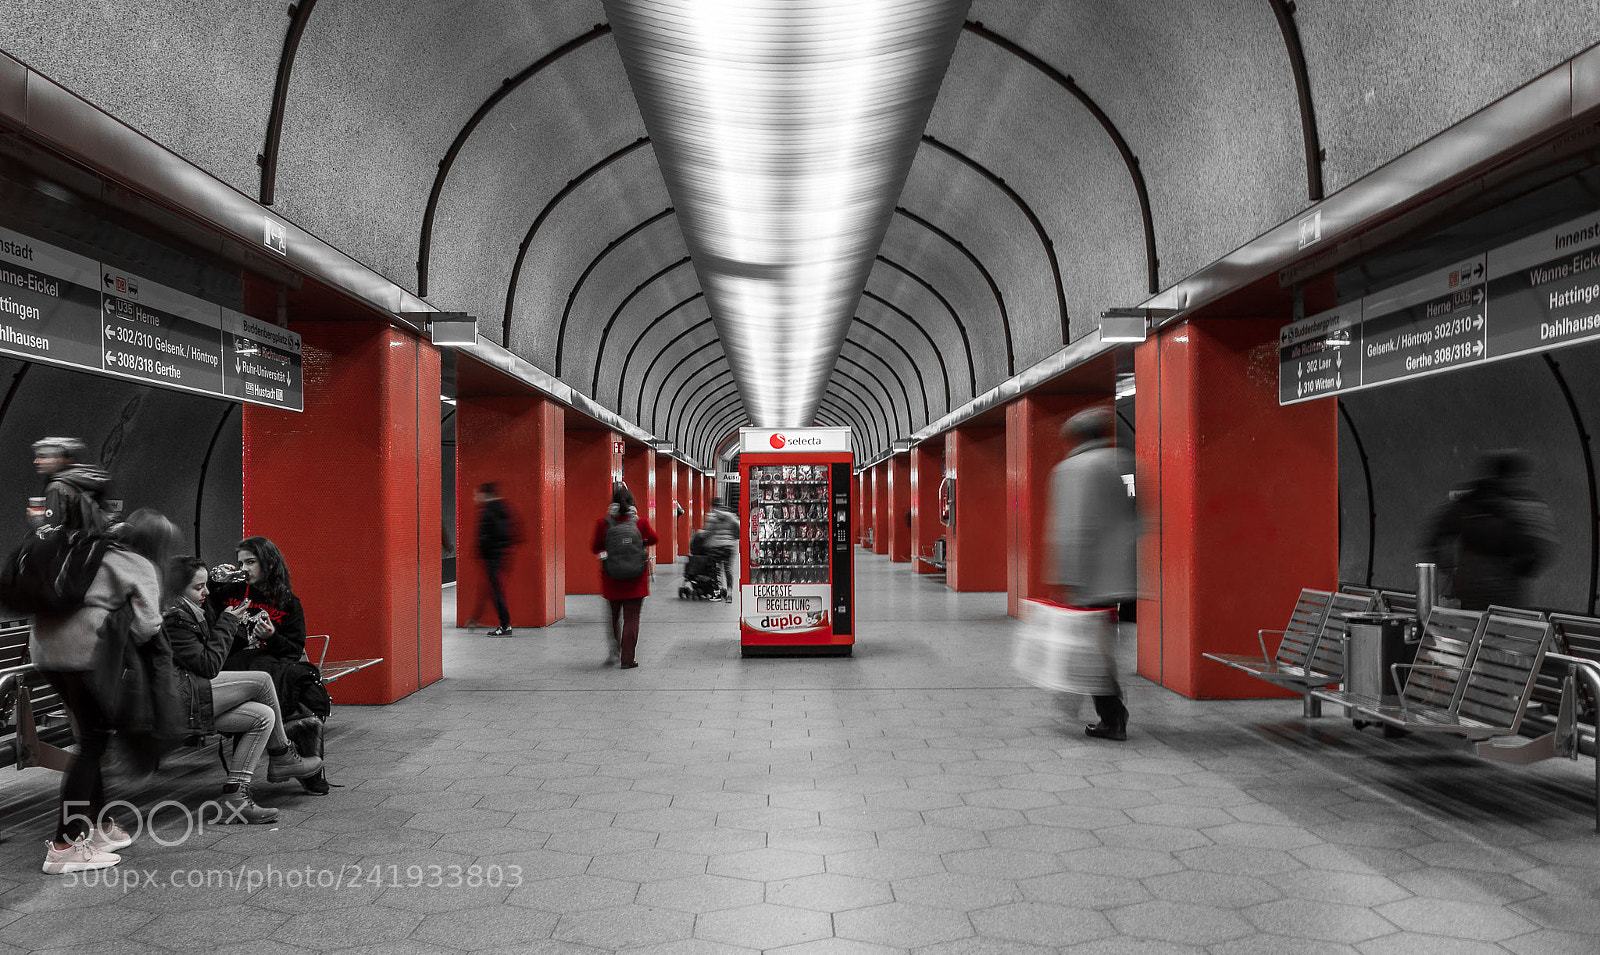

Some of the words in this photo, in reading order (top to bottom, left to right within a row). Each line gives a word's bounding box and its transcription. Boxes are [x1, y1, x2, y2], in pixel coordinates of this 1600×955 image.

[1555, 222, 1600, 250] Innenst
[117, 300, 133, 315] U35
[135, 306, 160, 327] Herne
[1427, 301, 1451, 318] Herne
[243, 320, 287, 344] Buddenbergplatz
[1294, 315, 1340, 338] Buddenbergplatz
[1401, 330, 1433, 349] Höntrop
[1434, 316, 1471, 340] 302/310
[117, 327, 153, 349] 302/310
[191, 346, 219, 367] Höntrop
[1406, 352, 1432, 370] Gerthe
[1434, 342, 1471, 365] 308/318
[117, 352, 154, 373] 308/318
[155, 360, 181, 379] Gerthe
[242, 361, 286, 382] Ruhr-Universität
[1306, 360, 1318, 373] 302
[1319, 358, 1332, 370] Laer
[254, 384, 276, 400] Hustadt
[1303, 380, 1314, 394] 310
[1314, 377, 1335, 391] Witten
[787, 437, 822, 446] selecta
[753, 585, 793, 597] LECKERSTE
[766, 599, 810, 611] BEGLEITUNG
[760, 614, 802, 630] duplo
